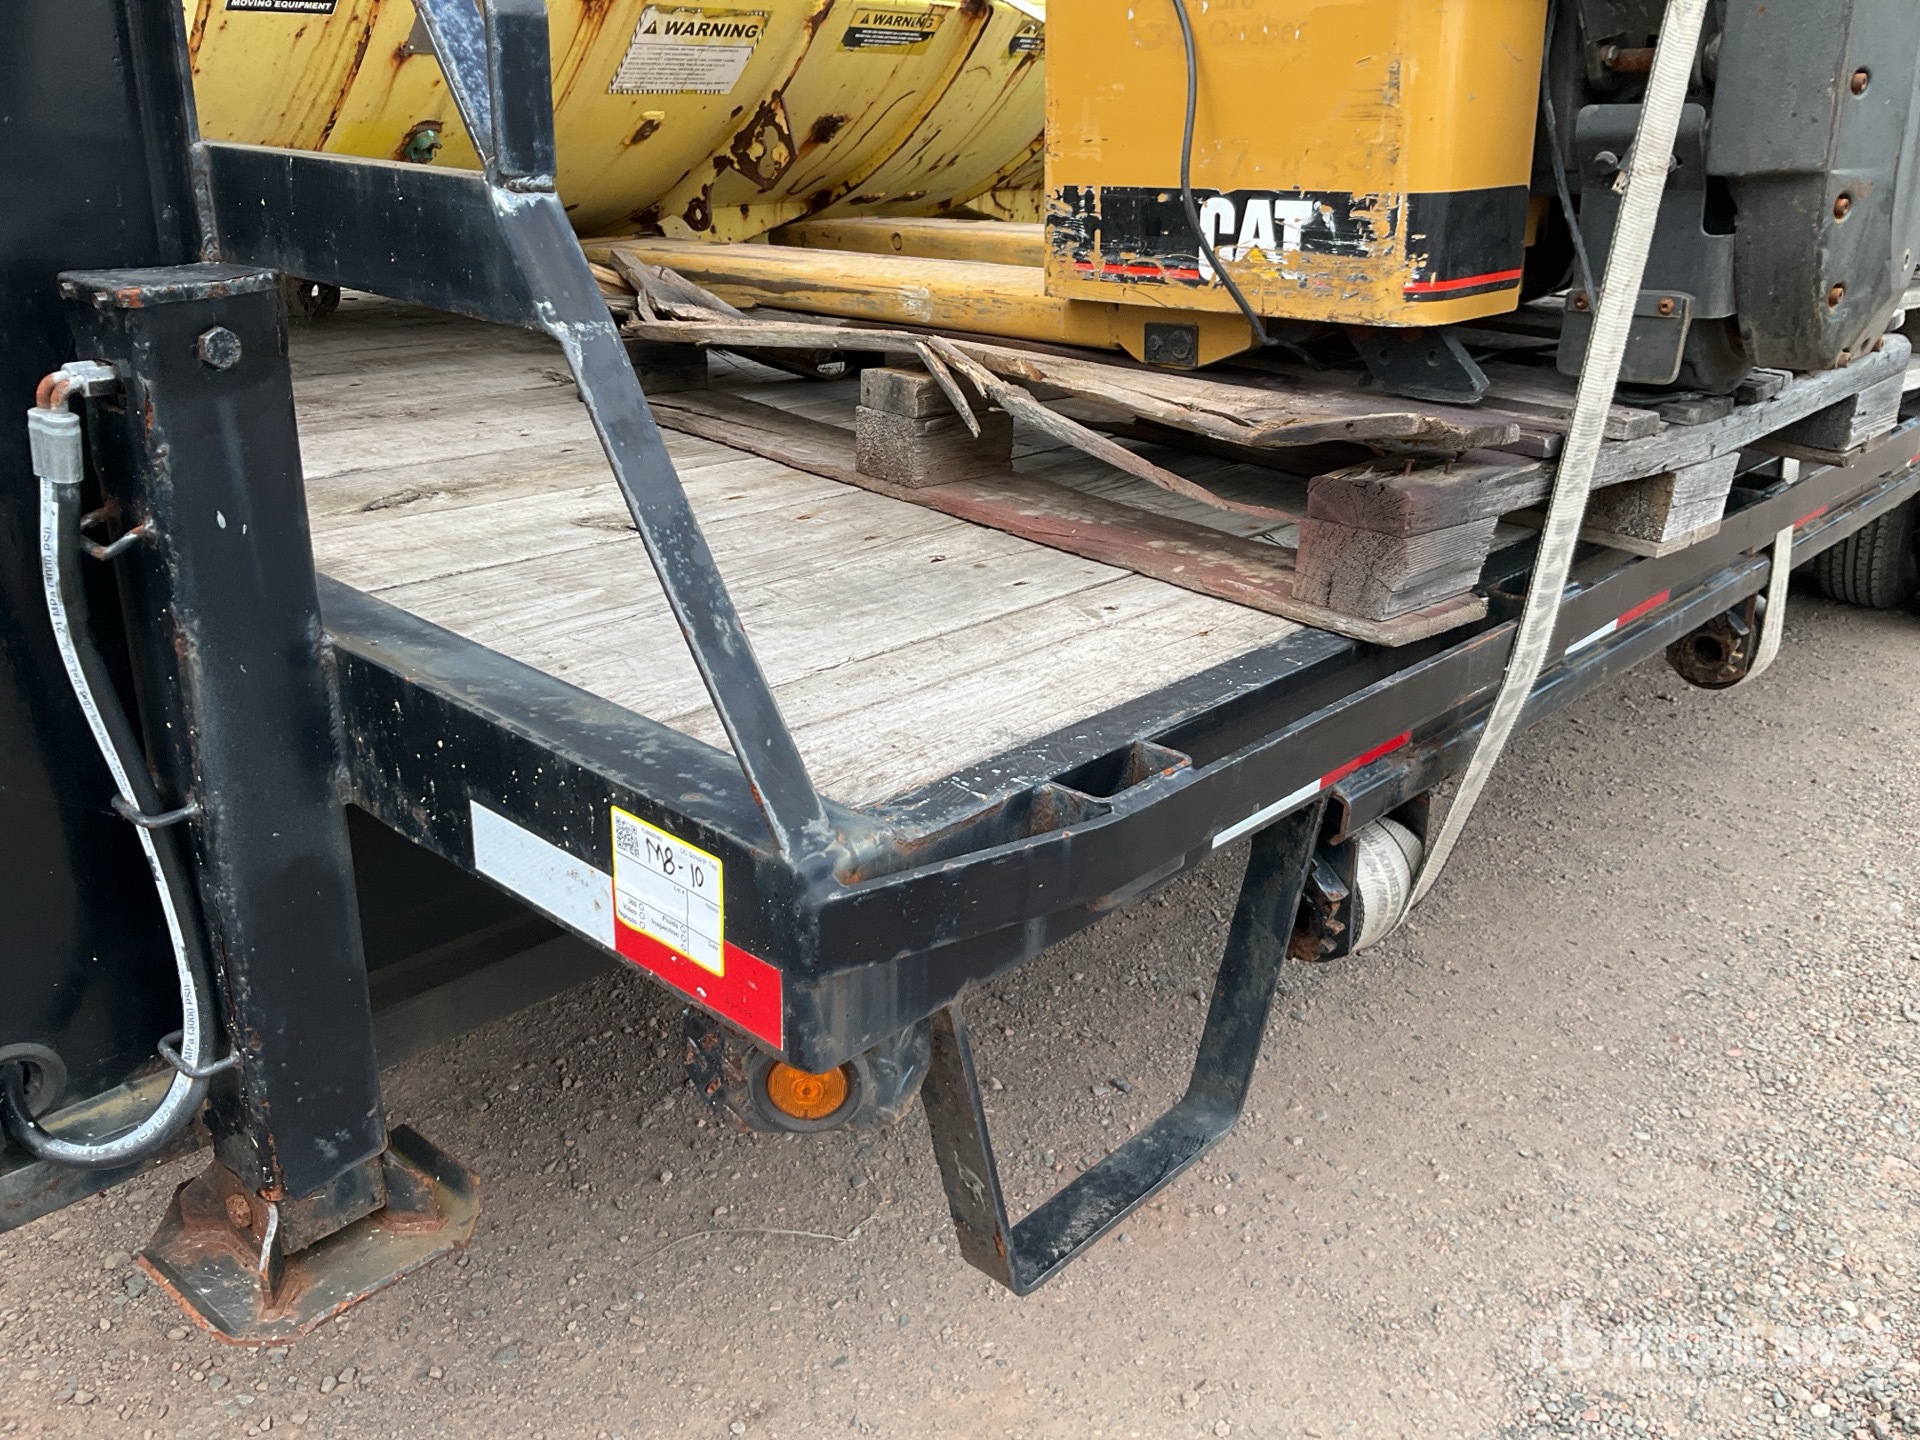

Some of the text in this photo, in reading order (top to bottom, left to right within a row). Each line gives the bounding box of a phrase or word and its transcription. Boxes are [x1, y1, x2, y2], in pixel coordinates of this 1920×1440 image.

[273, 0, 332, 10] EQUIPMENT
[664, 21, 759, 38] WARNING
[873, 14, 934, 29] WARNING
[1198, 197, 1314, 282] CAT
[50, 591, 61, 617] MPa
[651, 918, 680, 938] Inspection
[186, 1008, 196, 1036] (3000
[184, 1038, 195, 1061] MPa
